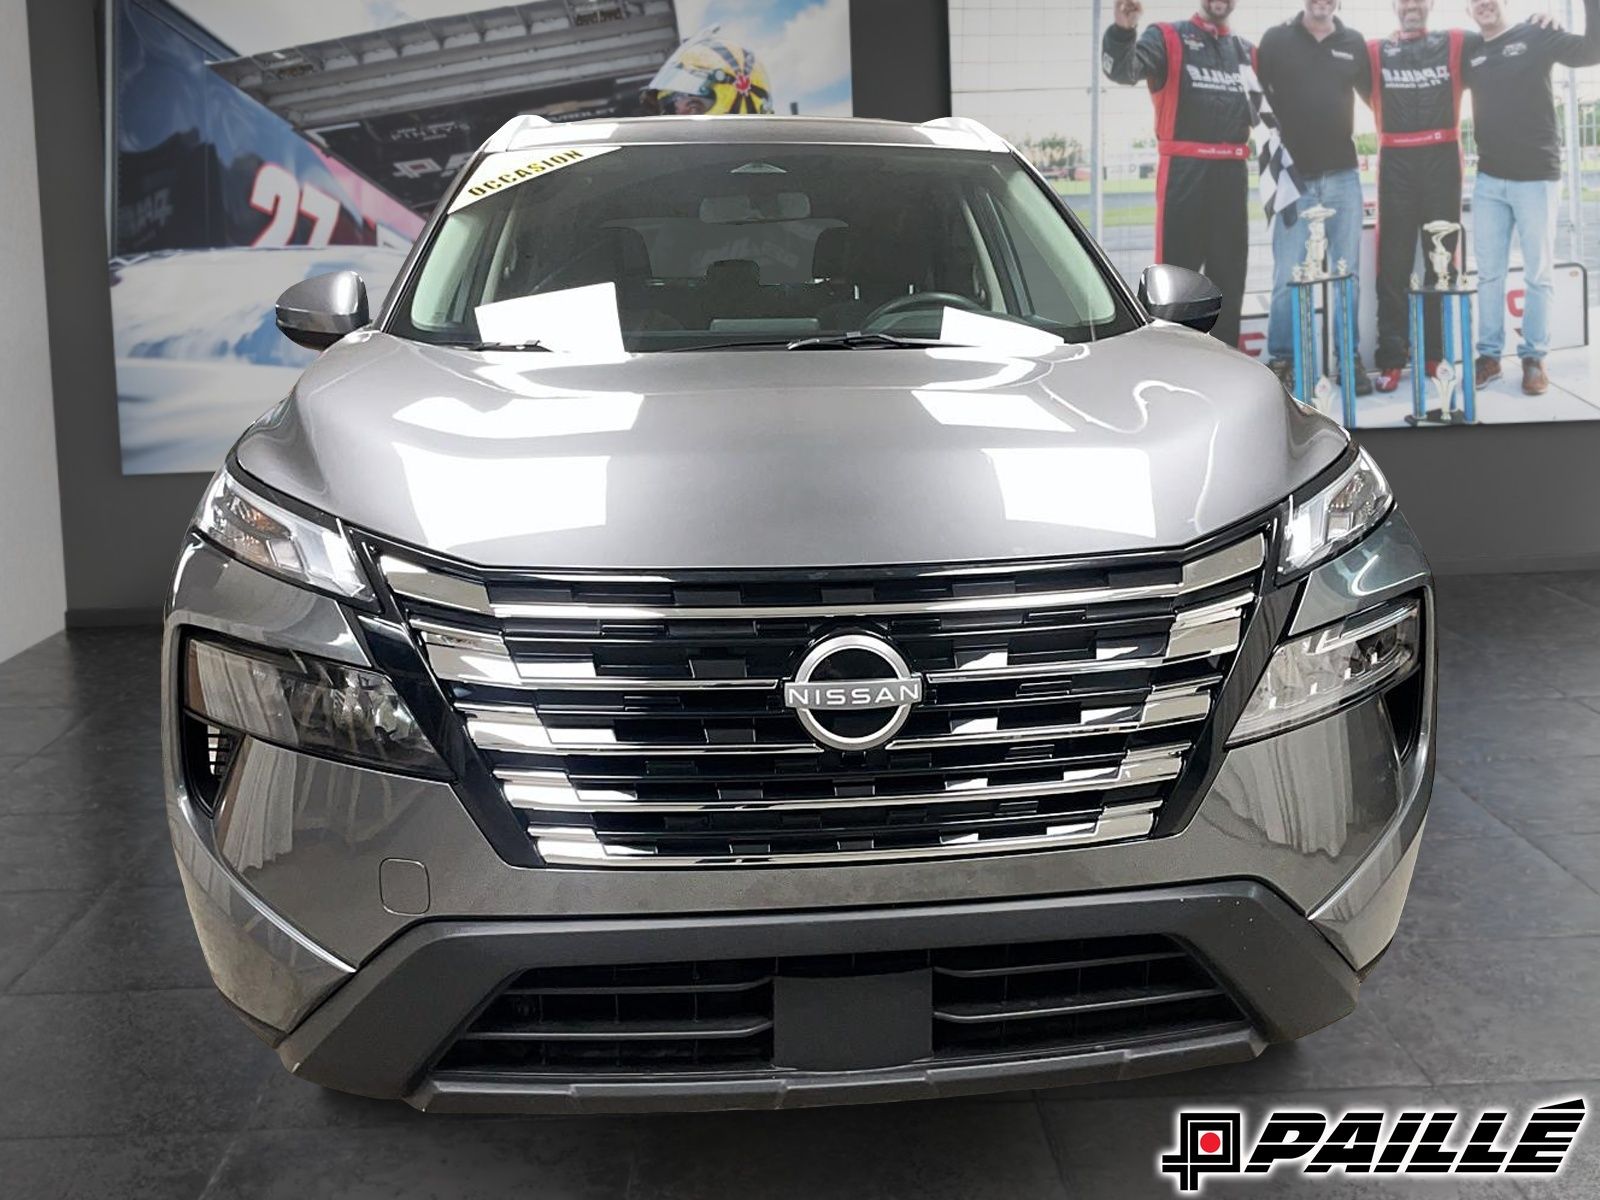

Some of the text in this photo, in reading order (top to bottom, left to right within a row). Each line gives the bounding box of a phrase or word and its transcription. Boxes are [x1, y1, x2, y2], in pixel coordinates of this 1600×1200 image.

[468, 149, 584, 197] OCCASION
[250, 163, 341, 248] 27
[788, 684, 919, 705] NISSAN
